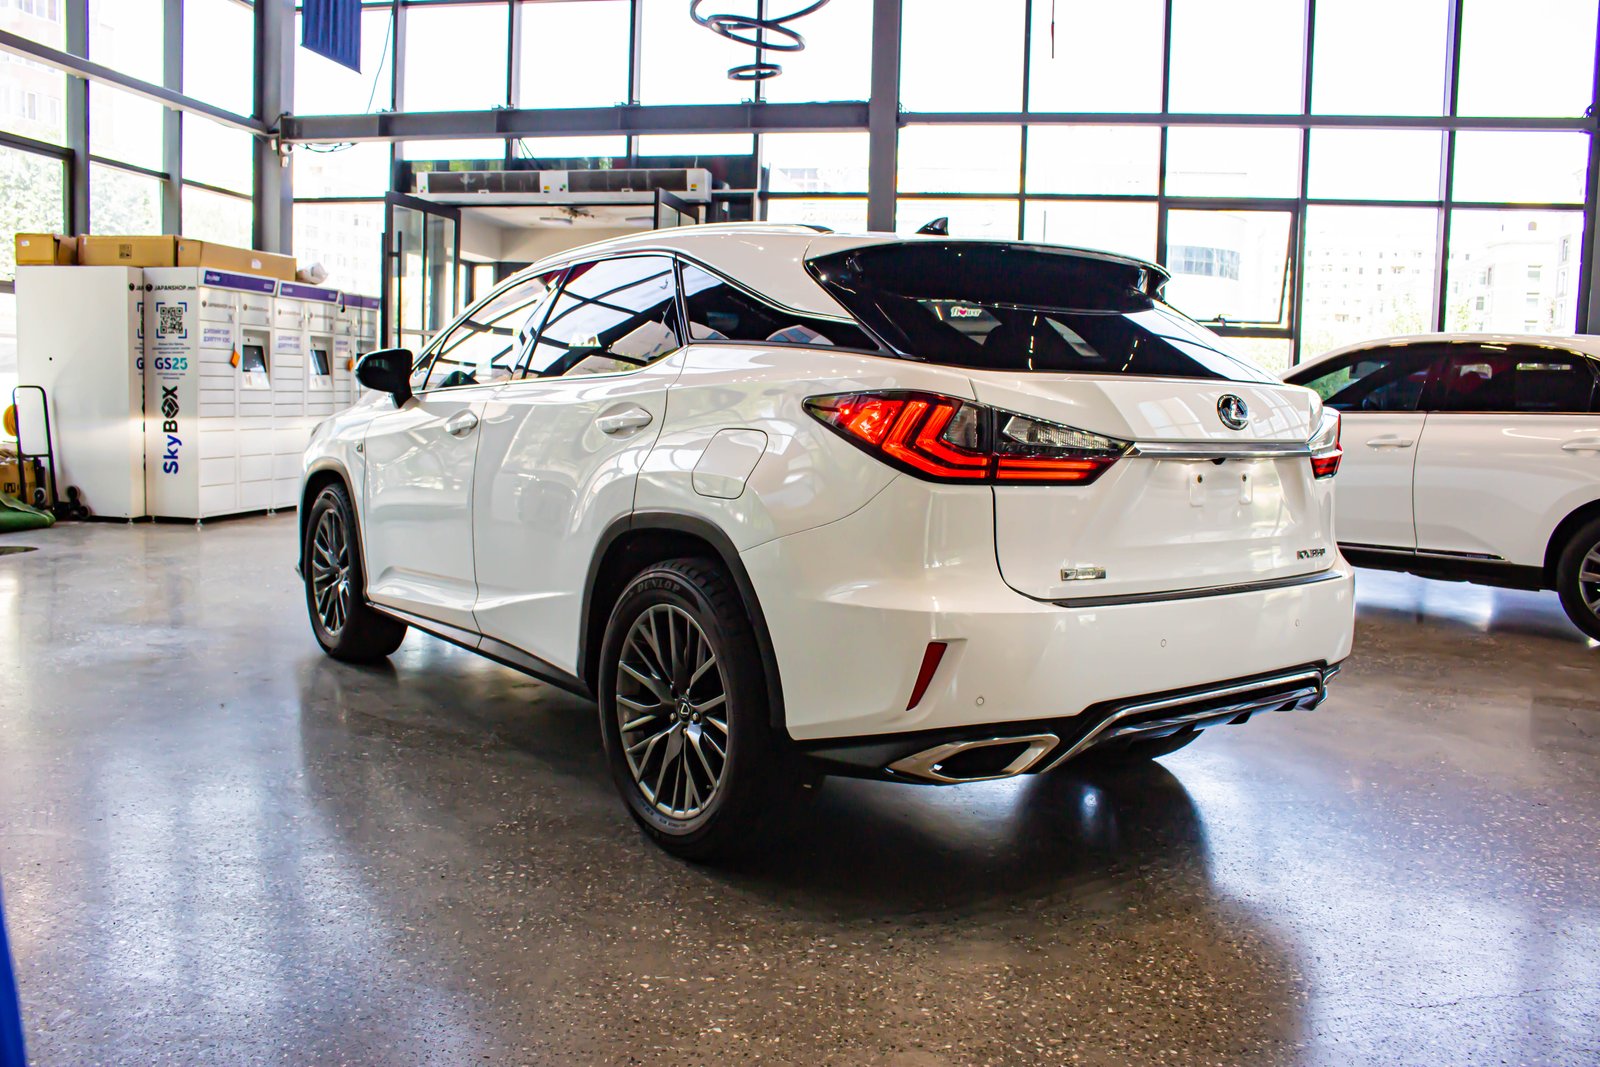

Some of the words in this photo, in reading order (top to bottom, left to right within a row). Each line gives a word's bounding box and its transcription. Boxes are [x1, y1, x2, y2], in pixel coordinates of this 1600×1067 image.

[154, 357, 188, 370] GS25
[161, 385, 182, 475] SkyBOX
[637, 579, 681, 593] DUNLOP
